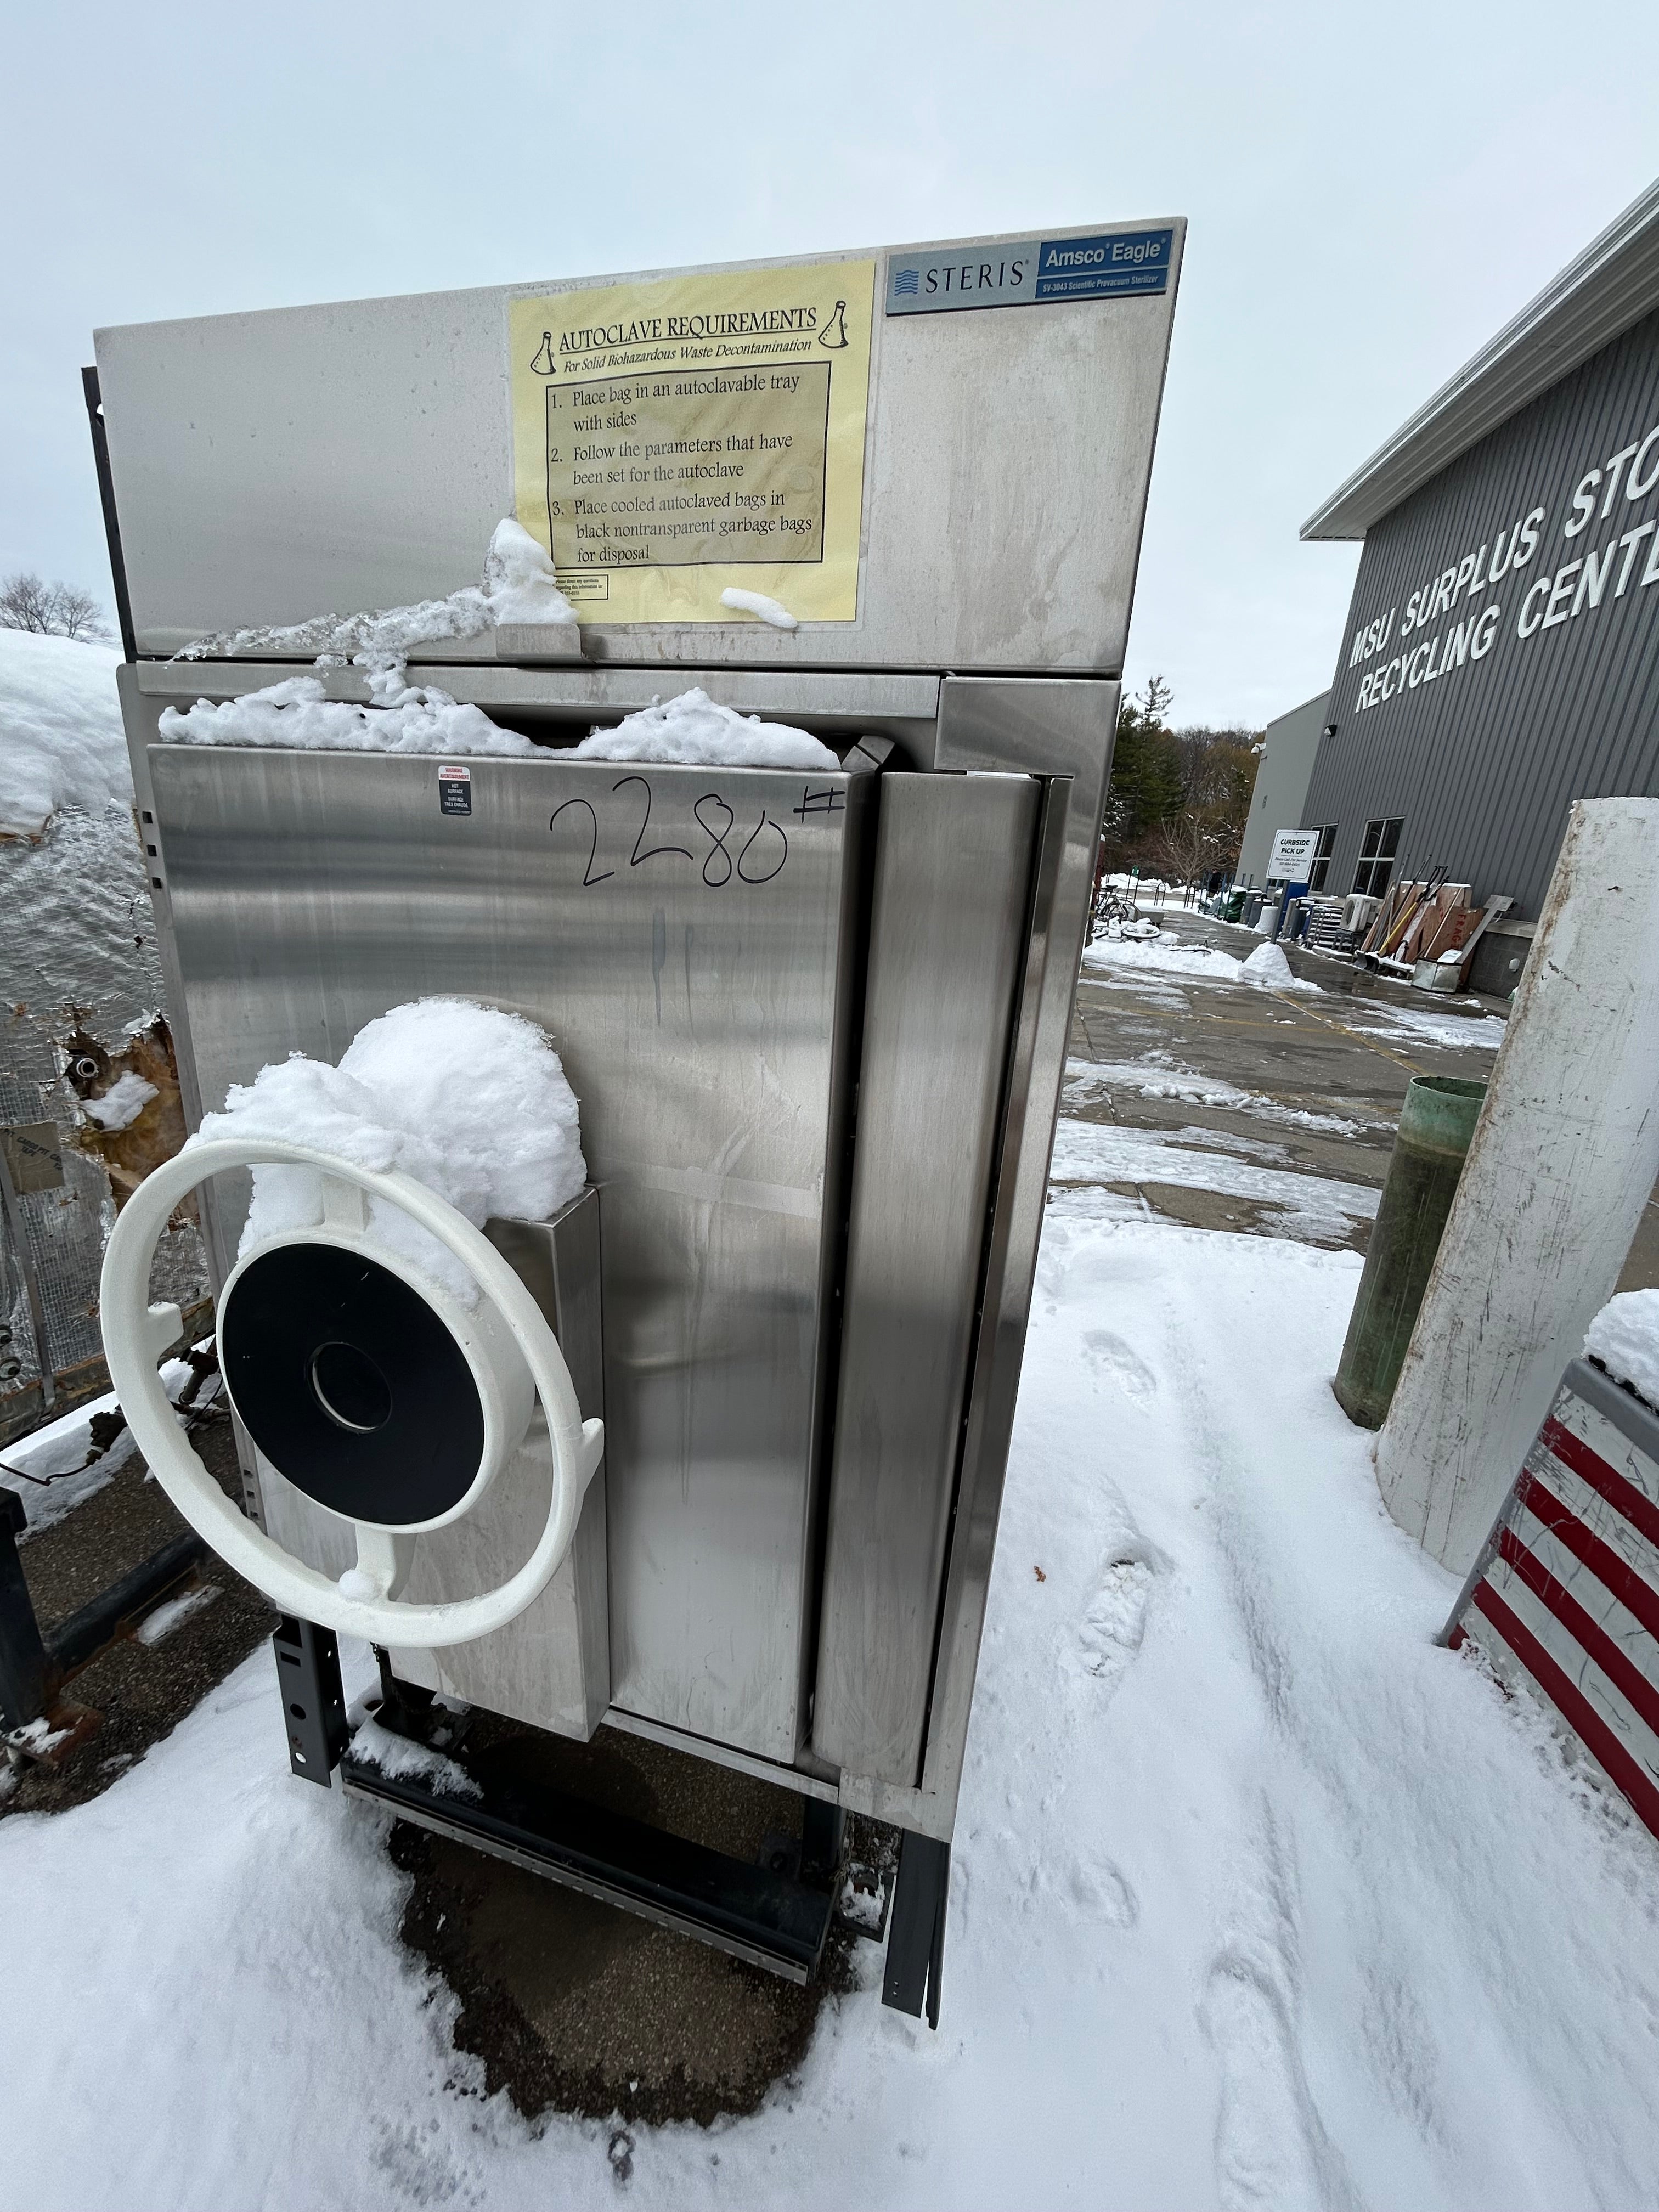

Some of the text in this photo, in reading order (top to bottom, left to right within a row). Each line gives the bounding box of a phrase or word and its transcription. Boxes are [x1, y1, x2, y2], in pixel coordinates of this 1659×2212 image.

[1046, 240, 1161, 267] Amsco Eagle
[926, 261, 1023, 293] STERIS
[1043, 275, 1159, 292] SV-3043 Scientific Prevacuum Sterilizer
[559, 307, 817, 351] AUTOCLAVE REQUIREMENTS
[564, 338, 811, 374] For Solid Biohazardous Waste Decontamination
[552, 374, 800, 409] 1. Place bag in an autoclavable tray
[573, 411, 637, 432] with sides
[551, 433, 793, 462] 2. Follow the parameters that have
[573, 461, 744, 485] been set for the autoclave
[552, 490, 785, 516] 3. Place cooled autoclaved bags in
[576, 515, 812, 539] black nontransparent garbage bags
[578, 544, 650, 565] for disposal
[1348, 607, 1396, 669] MSU
[1401, 506, 1547, 637] SURPLUS
[1355, 604, 1501, 714] RECYCLING
